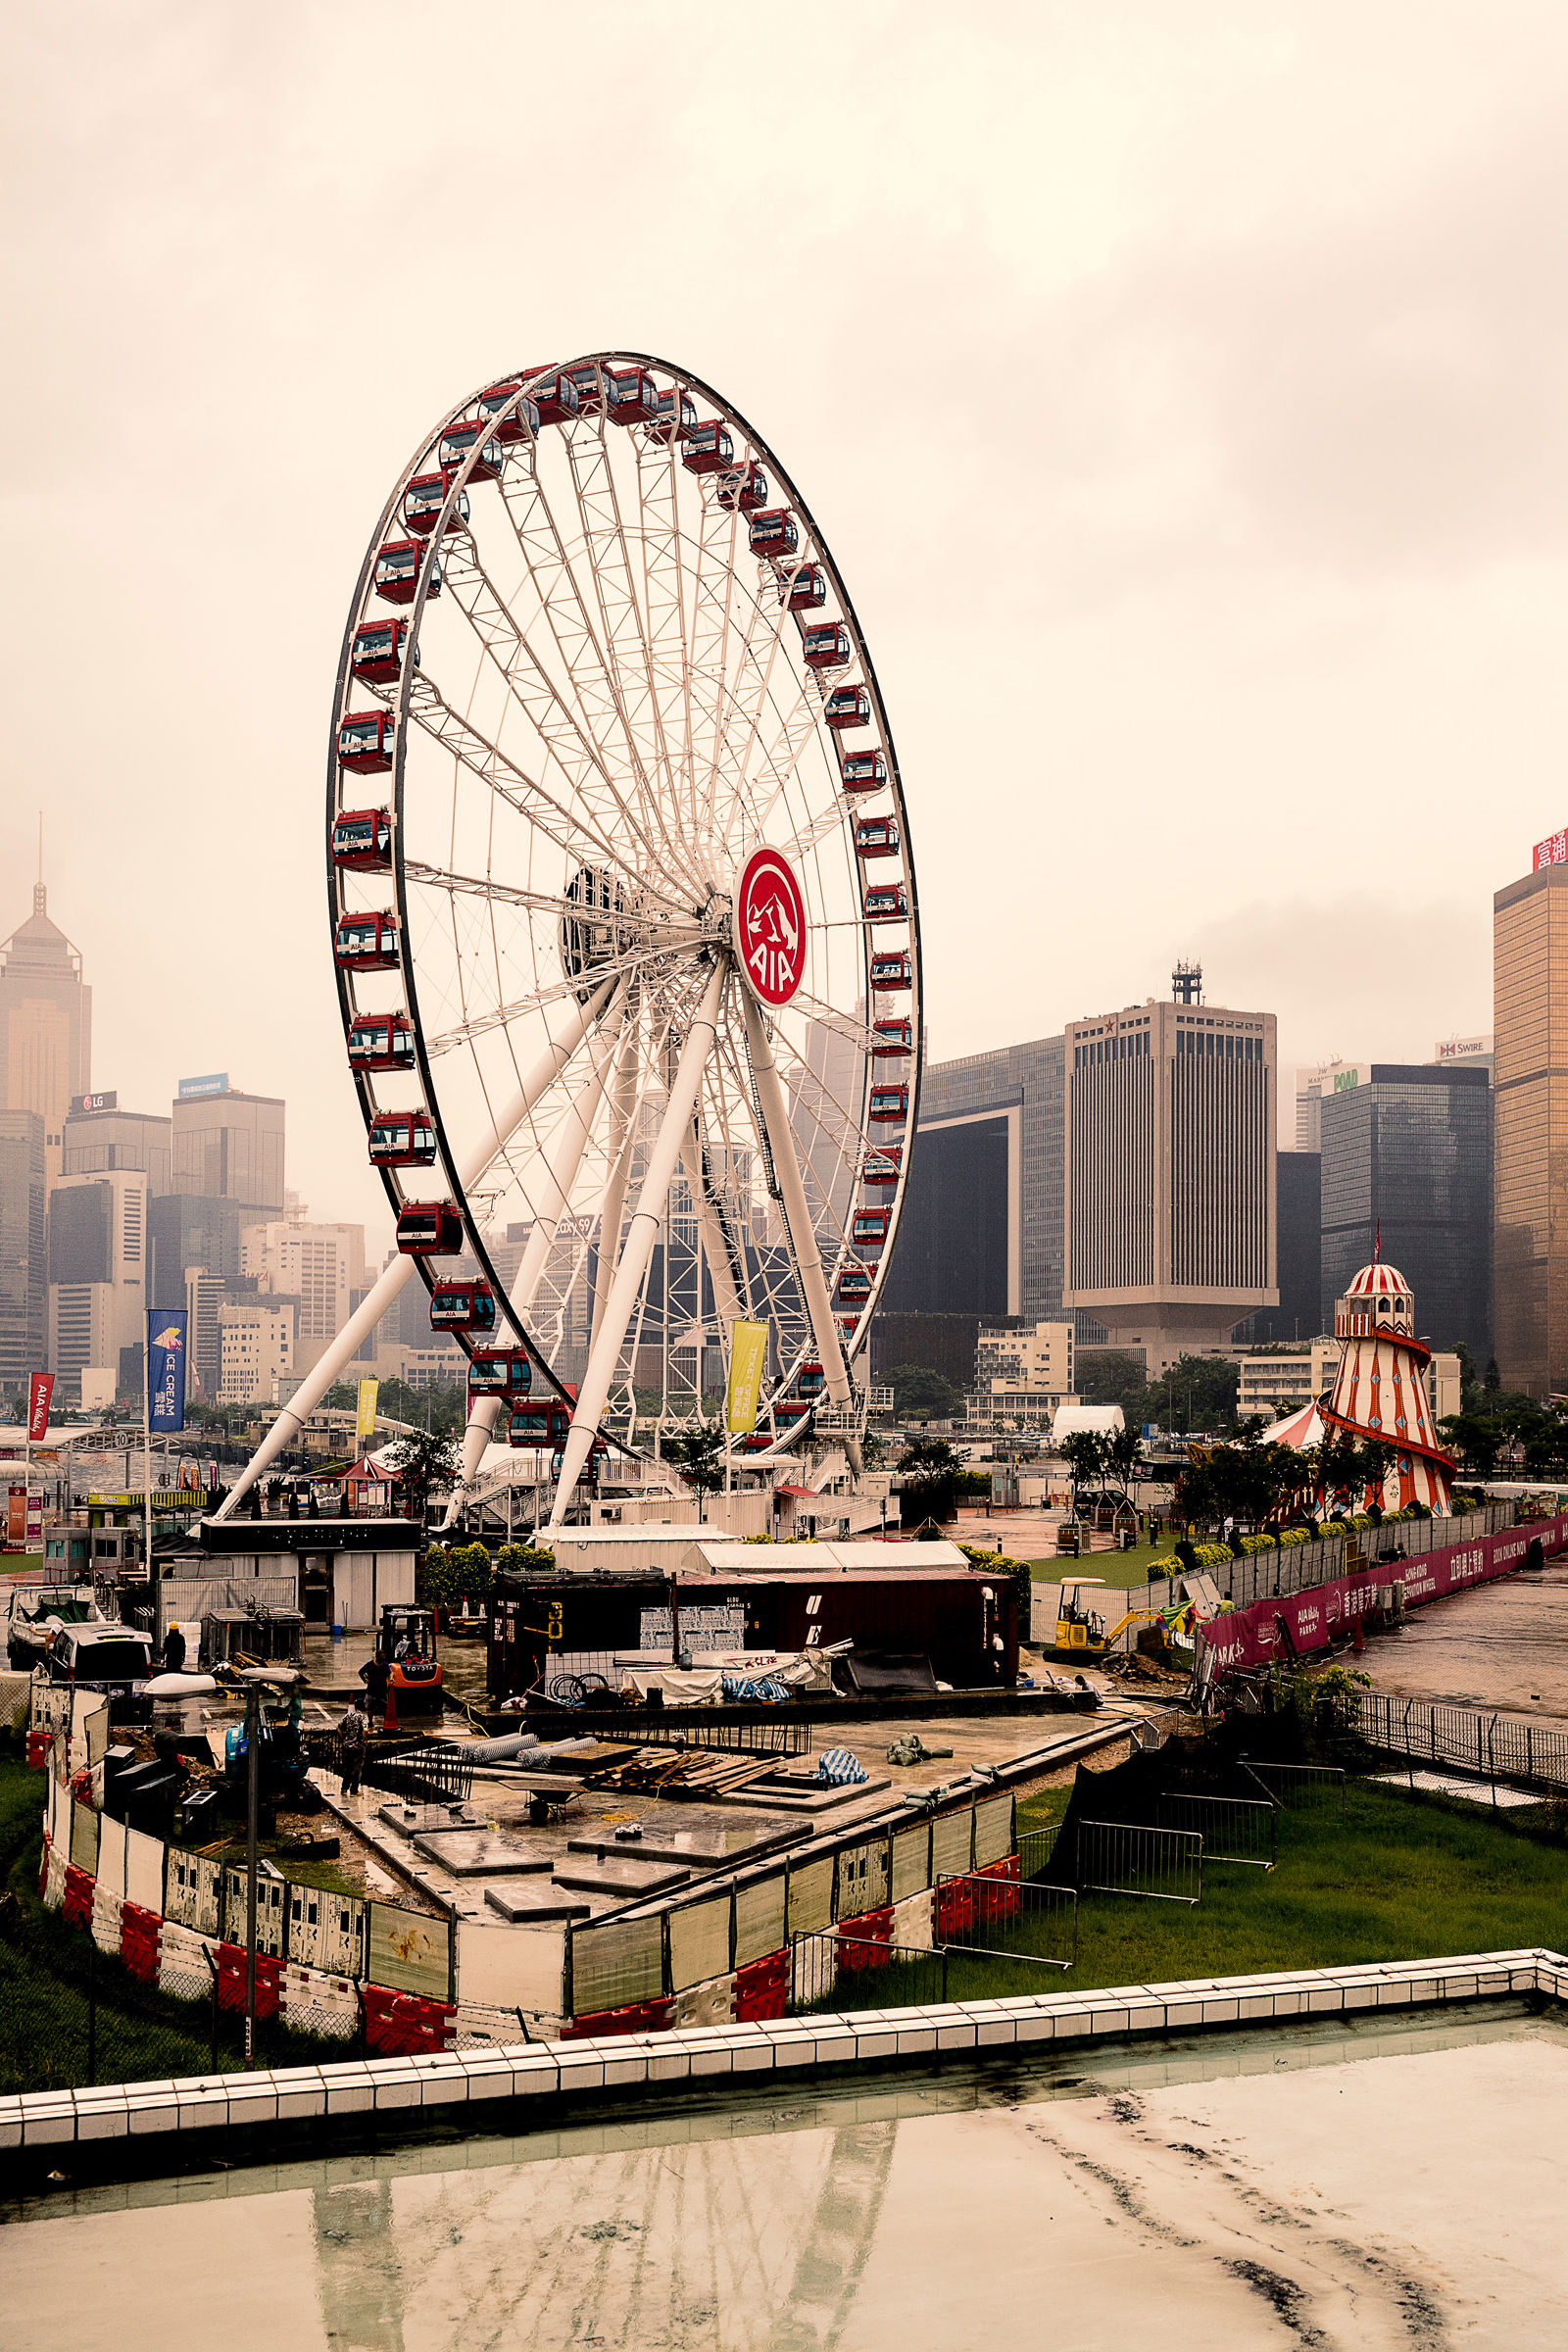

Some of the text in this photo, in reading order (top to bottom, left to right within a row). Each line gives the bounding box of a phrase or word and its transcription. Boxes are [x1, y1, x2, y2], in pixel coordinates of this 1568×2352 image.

[1538, 831, 1566, 869] 富通
[749, 943, 795, 992] AIA
[1457, 1042, 1484, 1055] SWIRE
[92, 1096, 104, 1107] LG
[166, 1353, 175, 1416] ICE CREAM
[742, 1348, 758, 1418] TICKET OFFICE
[36, 1384, 47, 1406] AIA
[154, 1392, 165, 1417] 雪糕
[117, 1434, 126, 1446] 10
[1298, 1608, 1307, 1624] AIA
[1299, 1625, 1313, 1637] PARK
